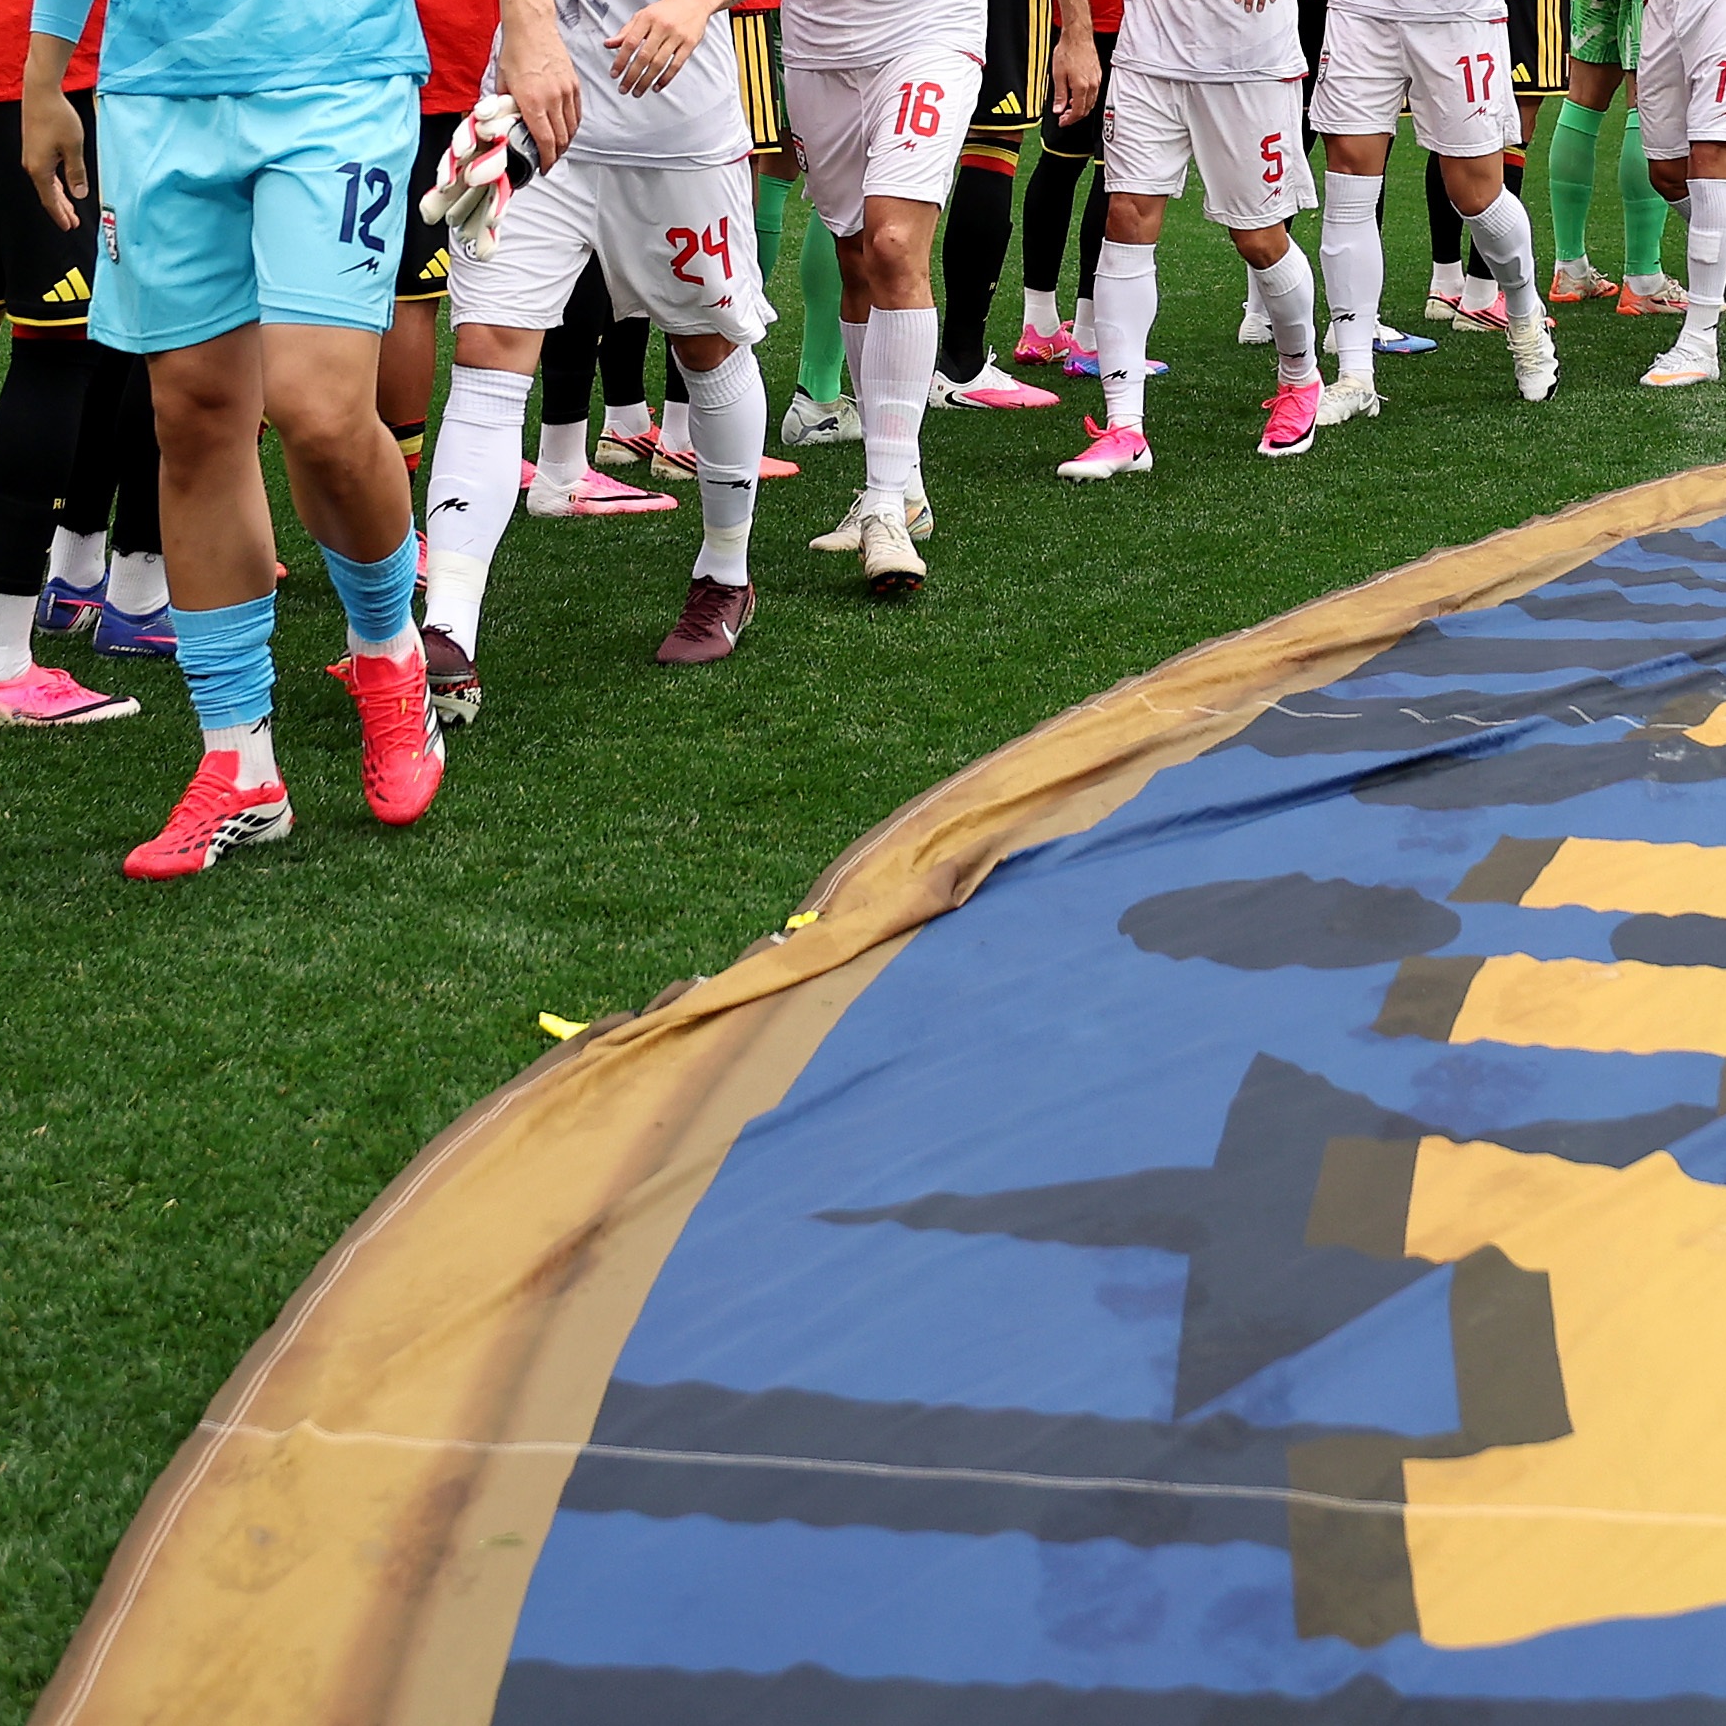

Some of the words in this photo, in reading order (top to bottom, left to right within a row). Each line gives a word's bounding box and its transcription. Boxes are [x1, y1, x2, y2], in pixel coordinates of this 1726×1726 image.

[1456, 52, 1495, 104] 17
[893, 81, 946, 138] 16
[1260, 132, 1284, 184] 5
[335, 161, 394, 254] 12
[665, 216, 734, 286] 24
